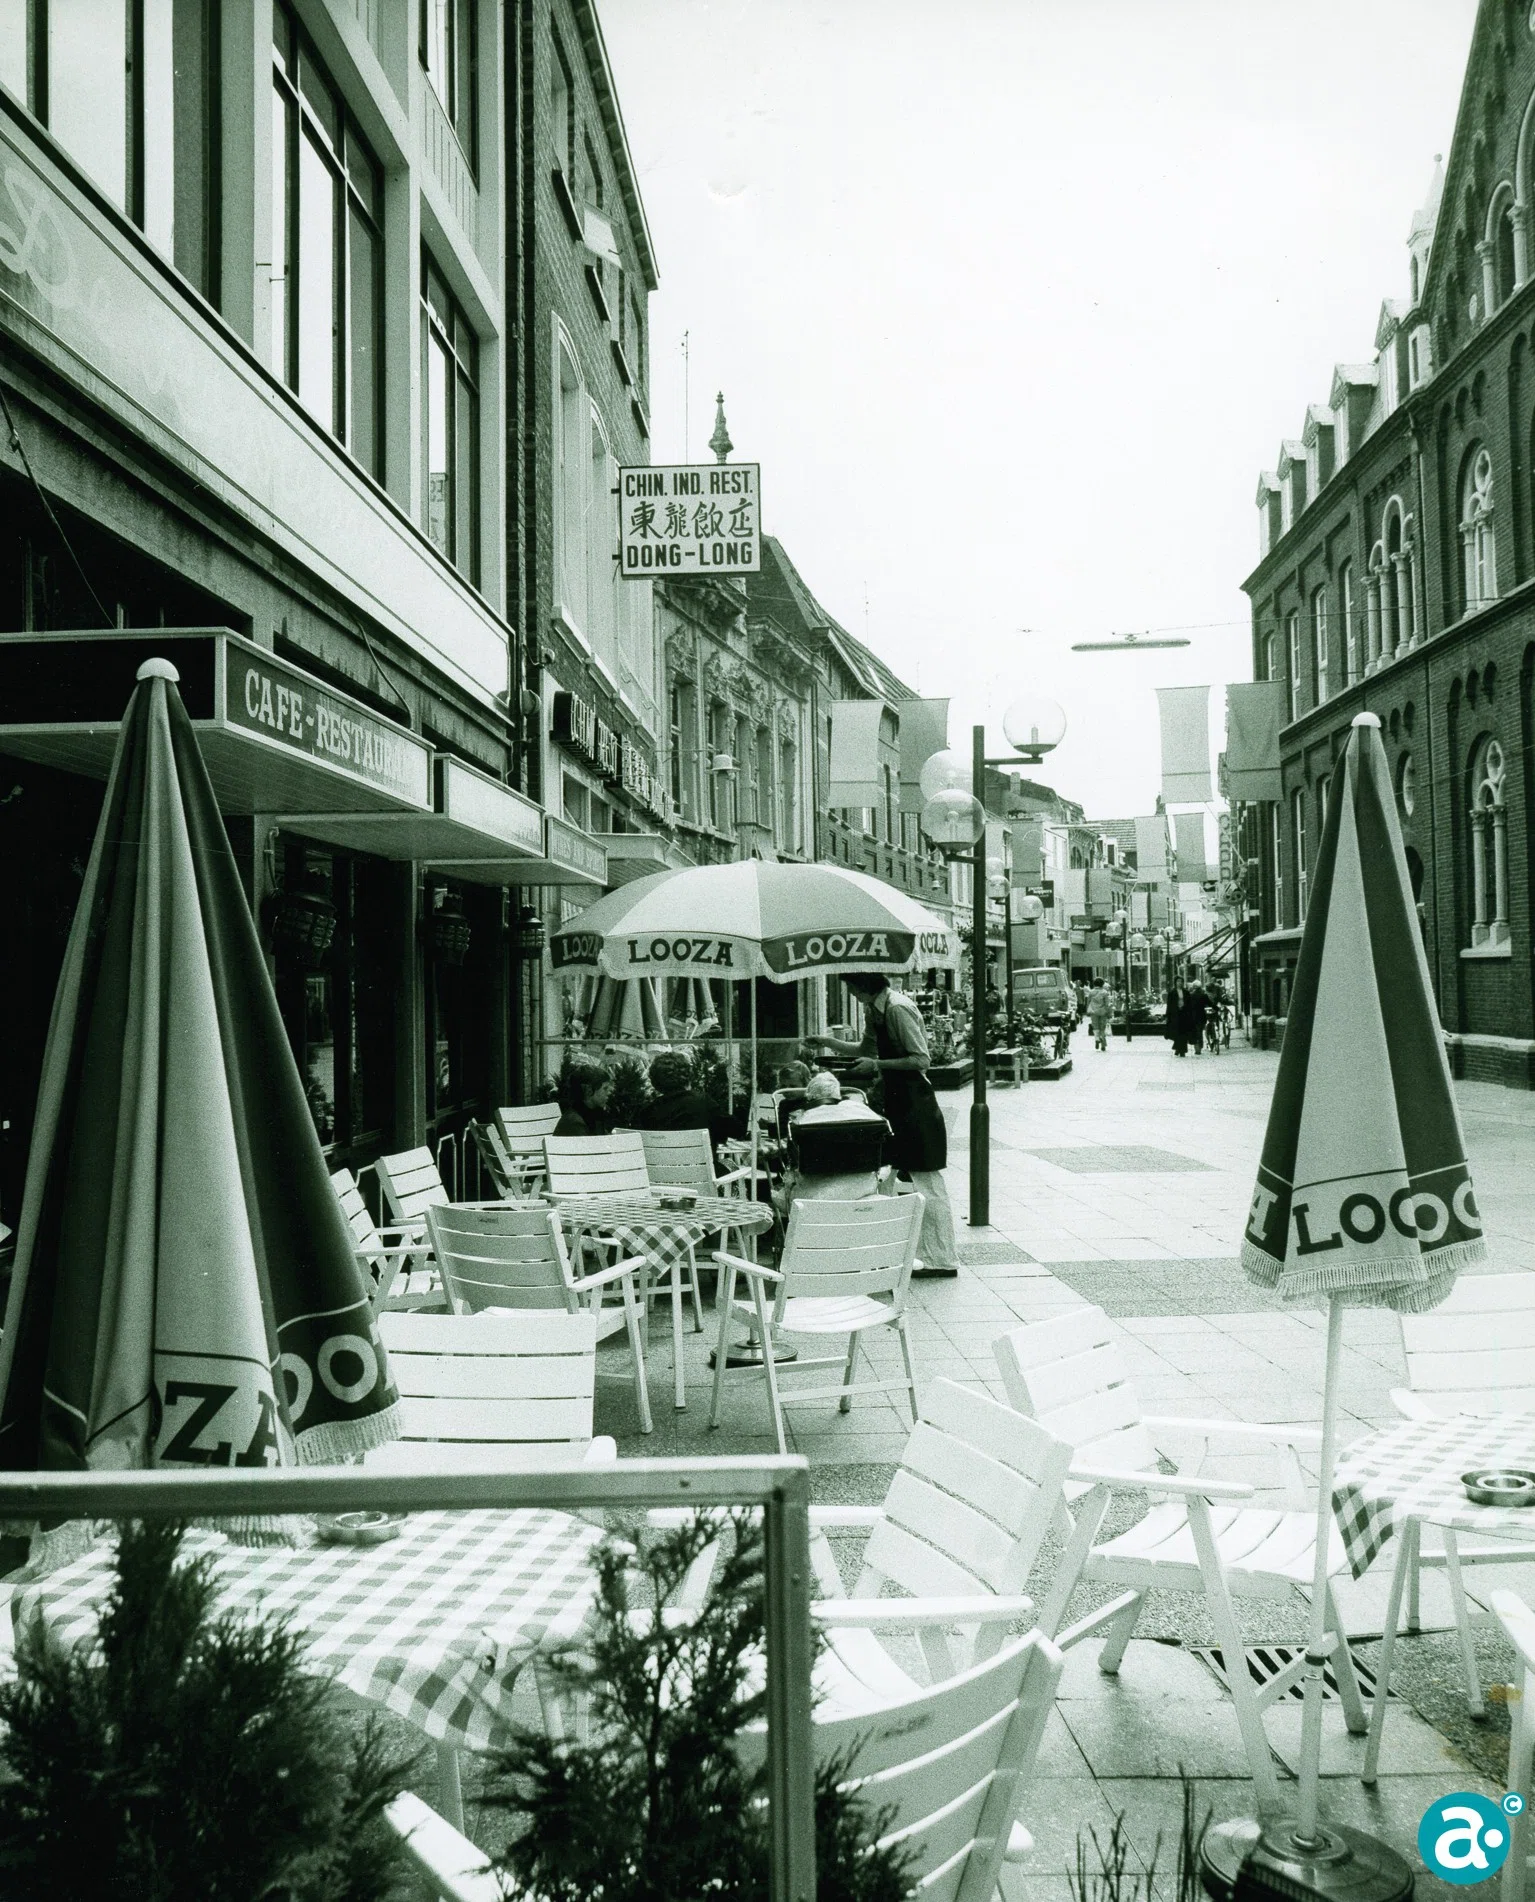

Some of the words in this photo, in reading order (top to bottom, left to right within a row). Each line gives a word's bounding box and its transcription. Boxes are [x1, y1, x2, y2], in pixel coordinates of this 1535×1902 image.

[625, 473, 668, 497] CHIN.
[673, 472, 705, 496] IND.
[709, 470, 753, 494] REST.
[627, 939, 734, 967] LOOZA
[785, 933, 890, 967] LOOZA
